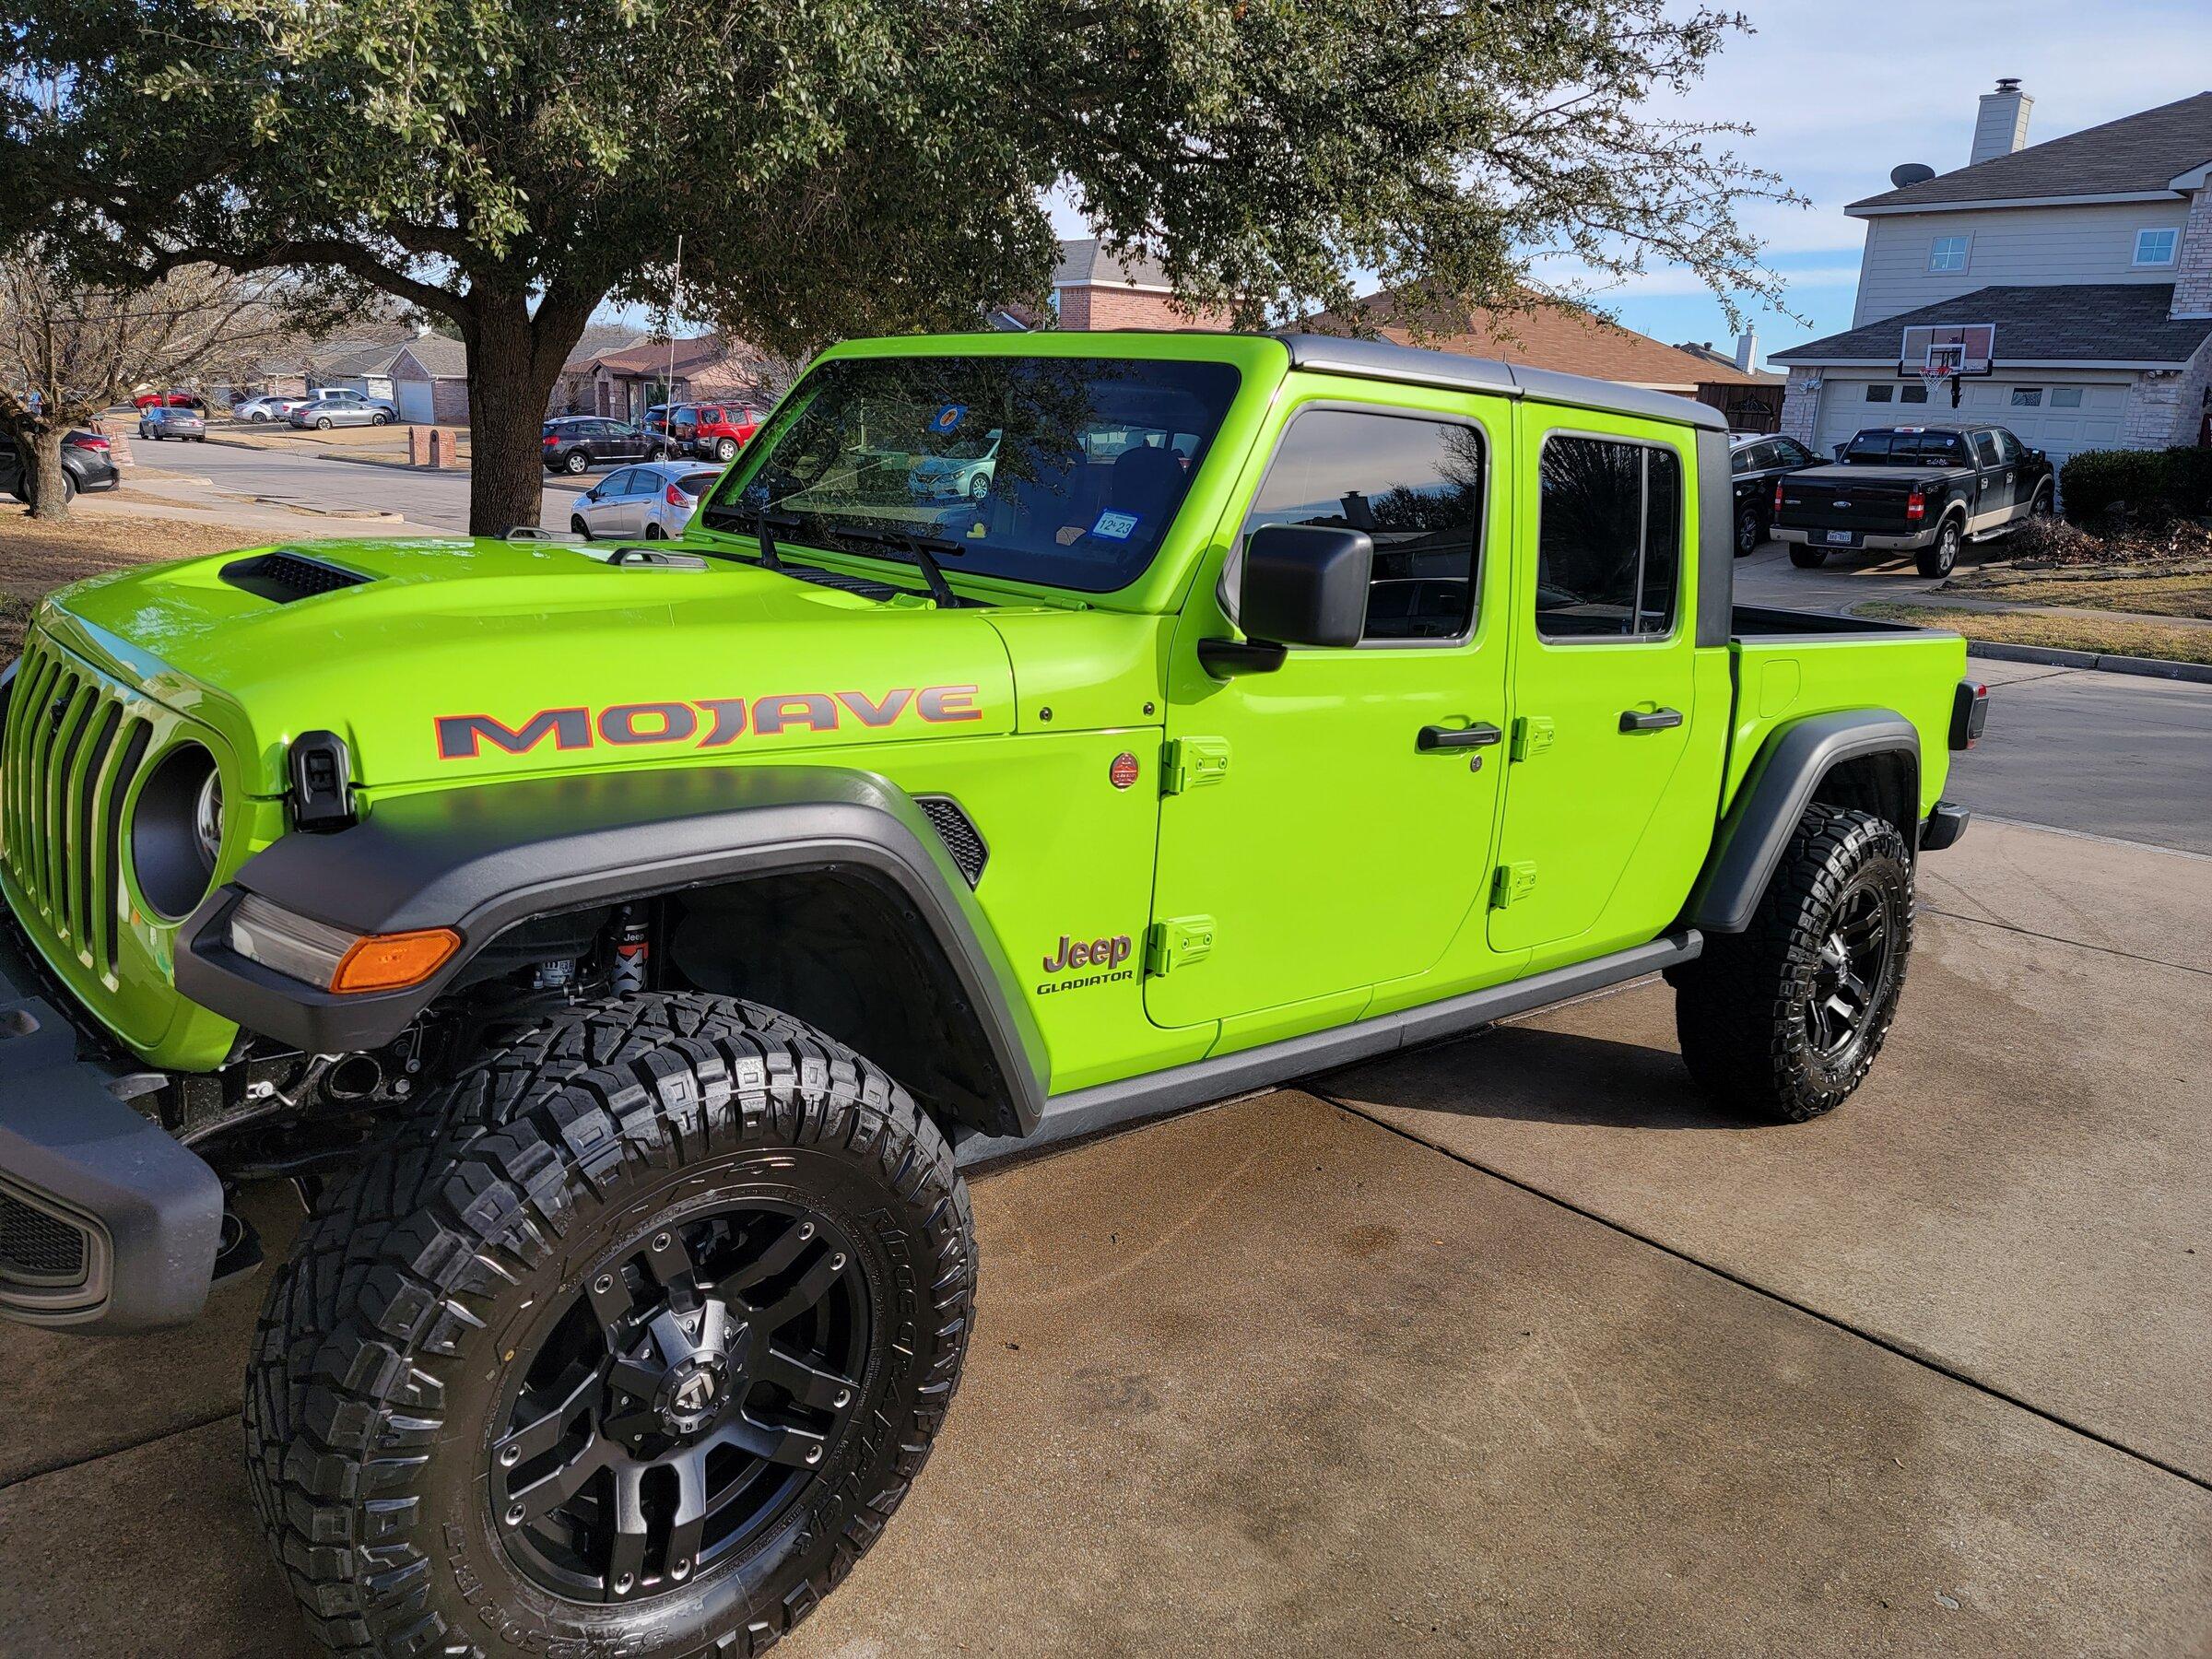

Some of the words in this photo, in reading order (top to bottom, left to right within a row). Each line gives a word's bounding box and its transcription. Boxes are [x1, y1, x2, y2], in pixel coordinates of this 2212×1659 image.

[435, 684, 982, 760] MOJAVE
[624, 933, 644, 942] Jeep
[1043, 934, 1132, 973] Jeep
[1036, 970, 1133, 995] GLADIATOR
